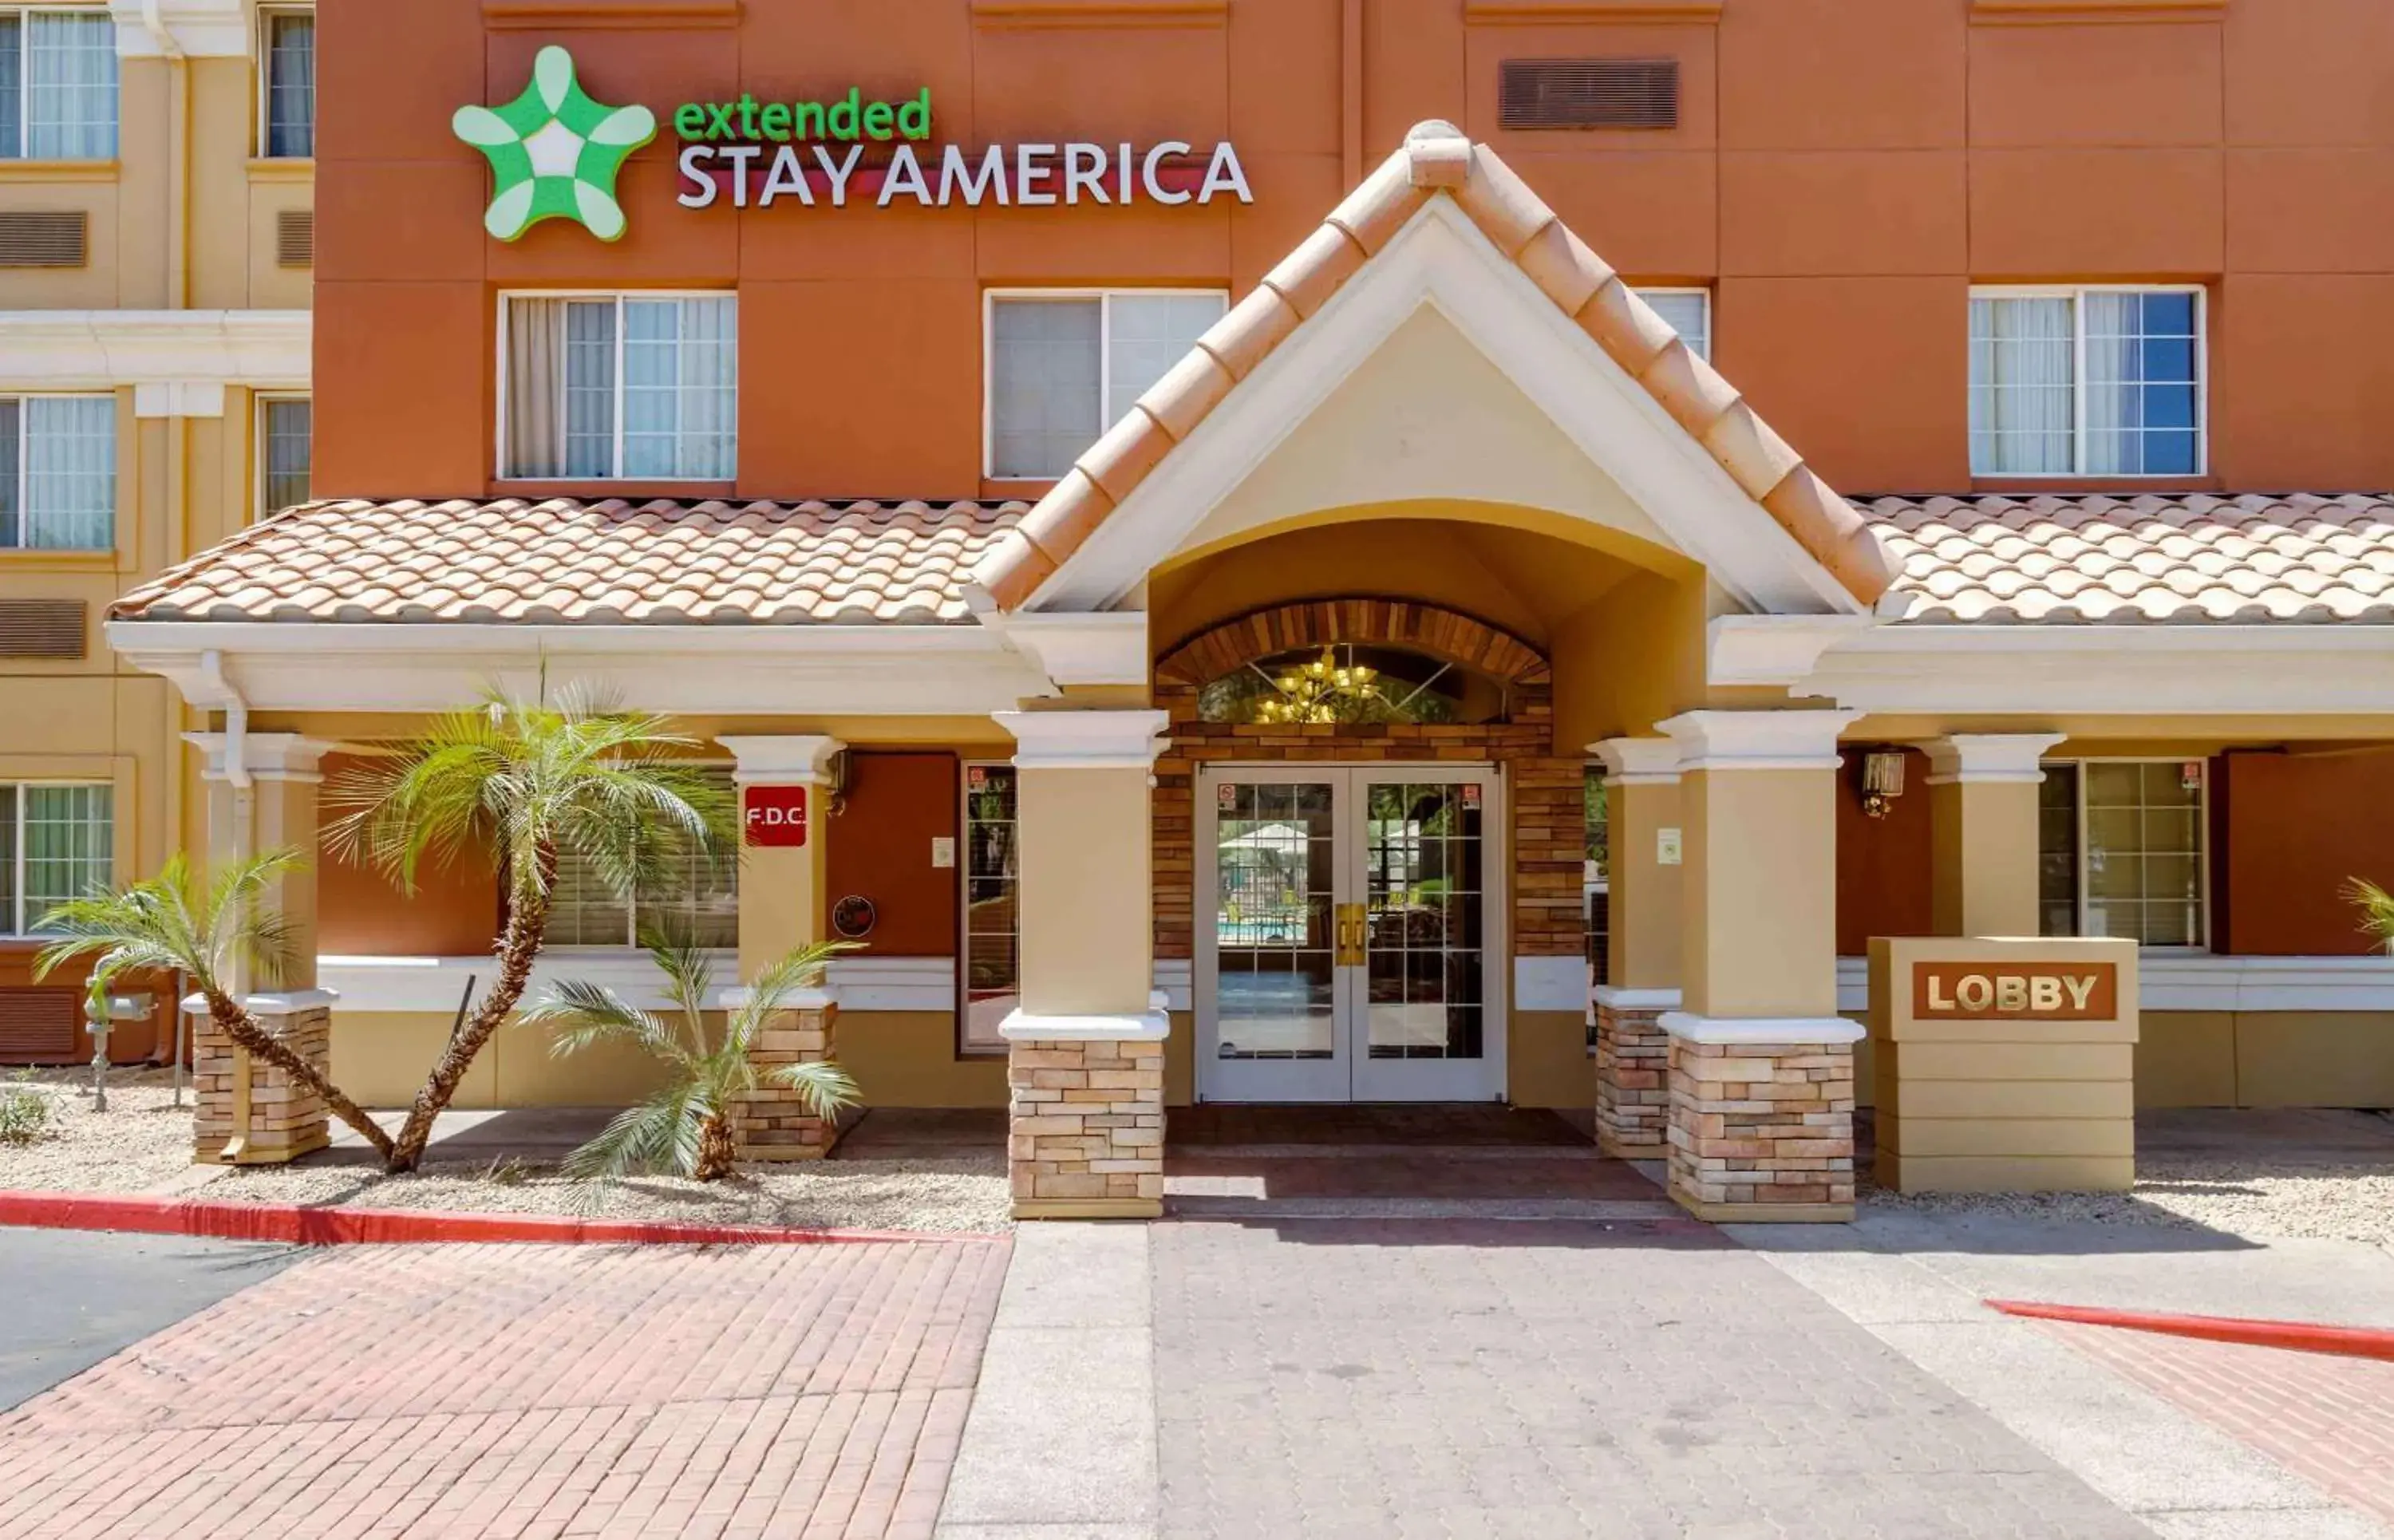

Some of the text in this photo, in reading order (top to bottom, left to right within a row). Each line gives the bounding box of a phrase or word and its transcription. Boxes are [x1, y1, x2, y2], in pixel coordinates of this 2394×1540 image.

[674, 87, 930, 140] extended
[678, 142, 1254, 207] STAY AMERICA
[747, 807, 807, 825] F.D.C.
[1928, 974, 2098, 1012] LOBBY
